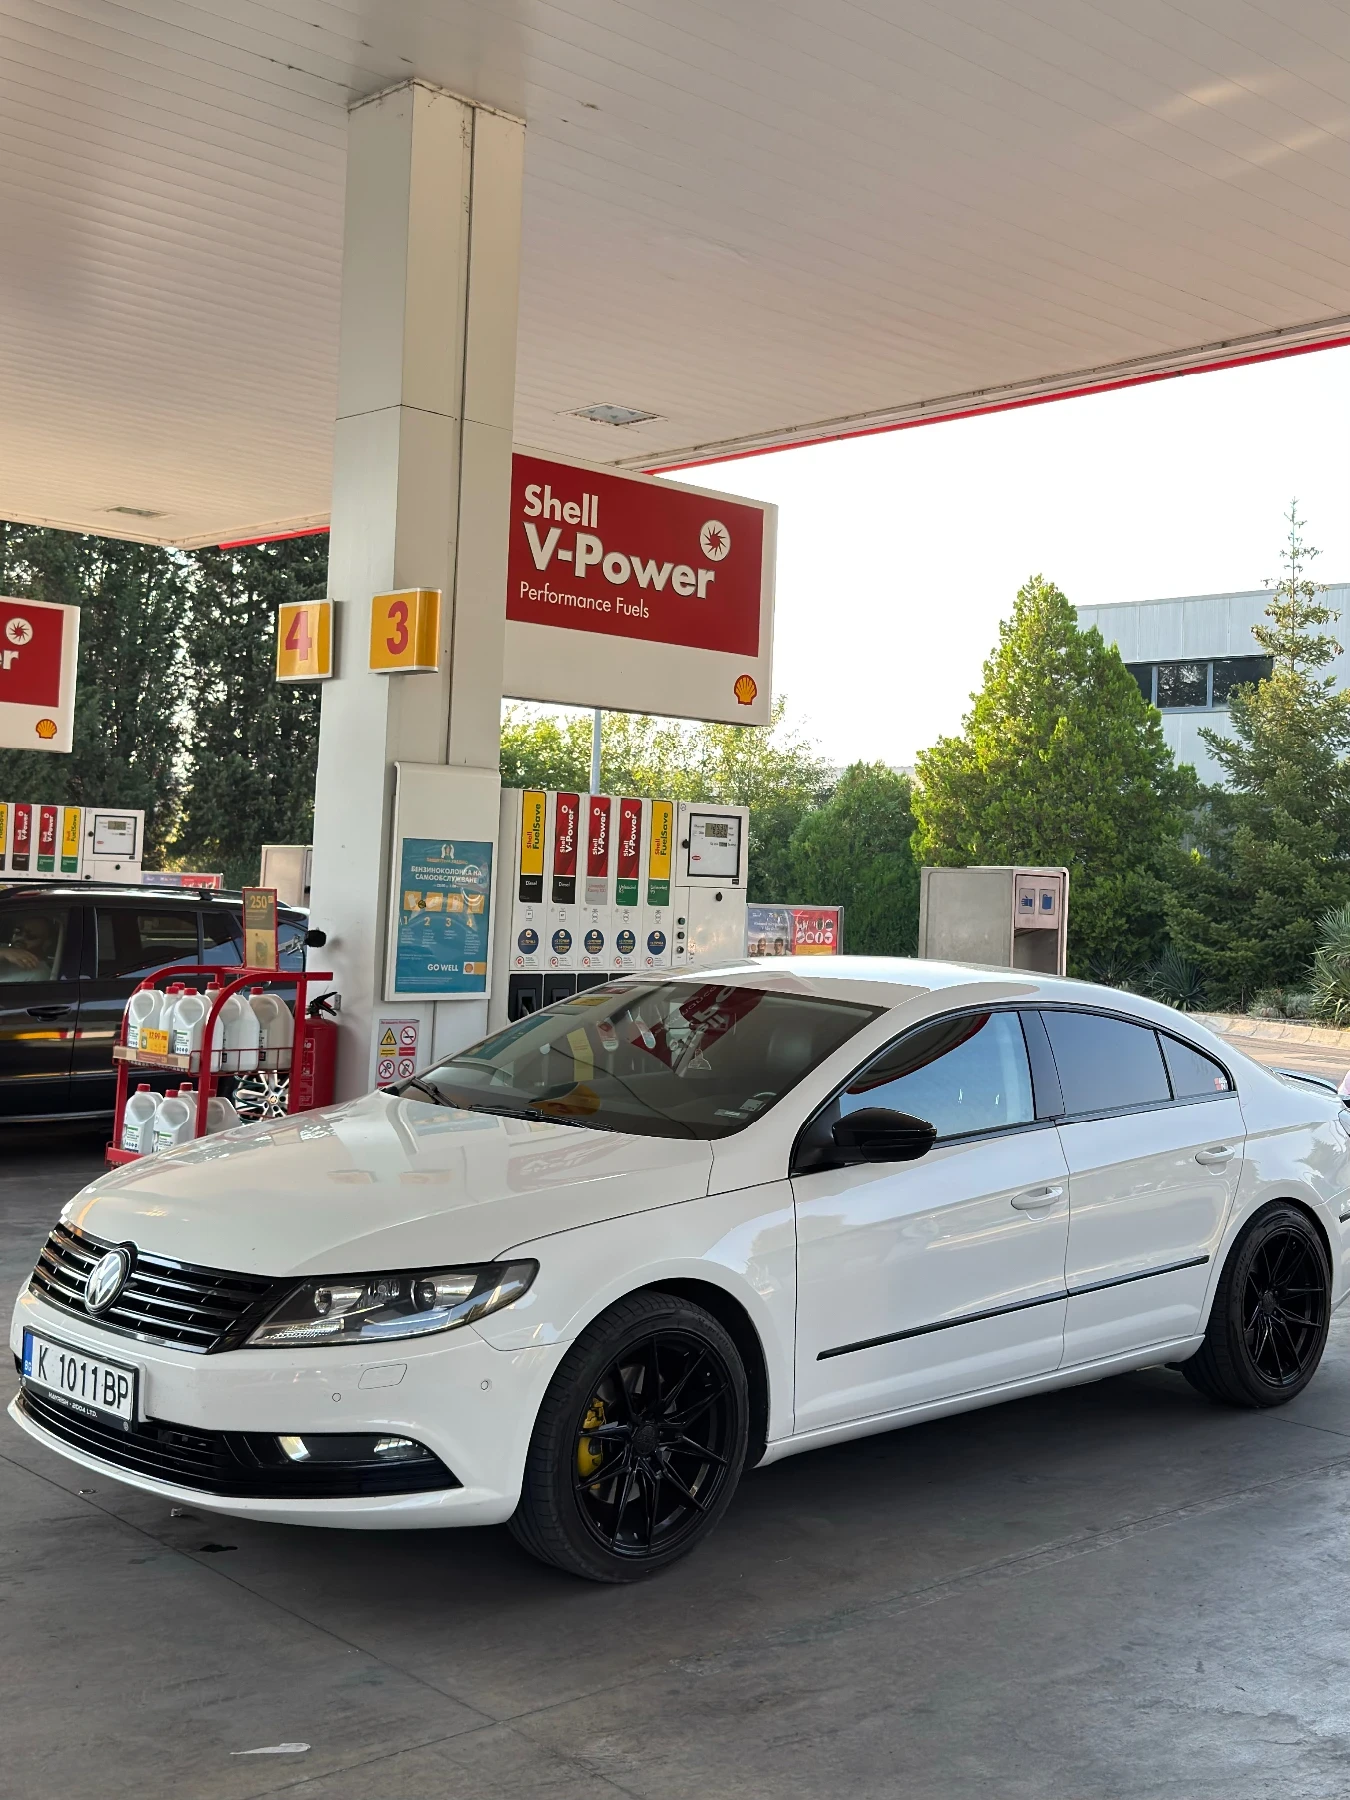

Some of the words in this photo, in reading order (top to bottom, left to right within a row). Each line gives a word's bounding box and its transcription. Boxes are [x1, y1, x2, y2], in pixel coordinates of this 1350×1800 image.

[523, 484, 599, 528] Shell
[522, 521, 716, 599] V-Power
[520, 581, 611, 612] Performance
[616, 597, 650, 619] Fuels
[285, 610, 312, 661] 4
[386, 600, 409, 656] 3
[532, 804, 542, 850] FuelSave
[565, 809, 574, 853] V-Power
[598, 812, 606, 855] V-Power
[628, 814, 637, 856] V-Power
[660, 812, 668, 856] FuelSave
[250, 896, 268, 909] 250
[404, 916, 408, 925] 1
[424, 916, 430, 926] 2
[446, 918, 451, 927] 3
[466, 918, 473, 928] 4
[24, 1360, 32, 1371] BG
[38, 1344, 49, 1381] K
[72, 1402, 85, 1413] 2004
